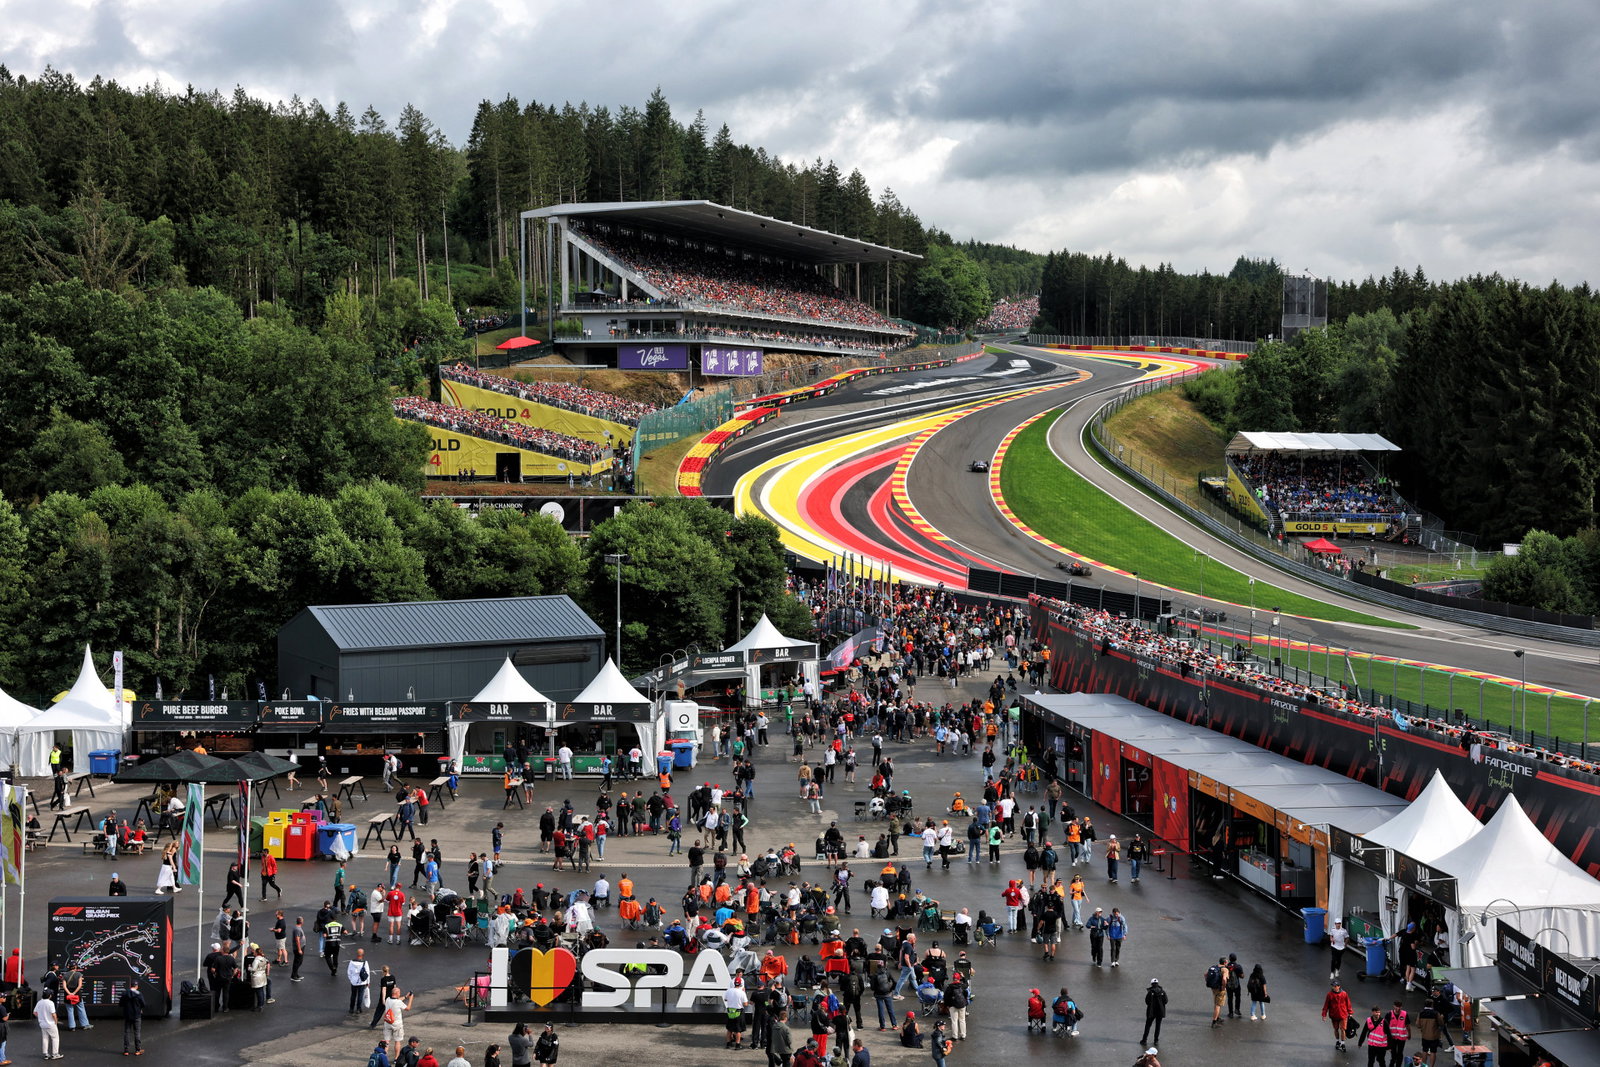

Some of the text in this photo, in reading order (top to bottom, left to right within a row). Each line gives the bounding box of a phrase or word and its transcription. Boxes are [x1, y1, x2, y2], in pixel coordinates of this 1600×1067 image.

[636, 348, 668, 367] Vegas
[520, 409, 531, 419] 4
[431, 438, 460, 451] OLD
[430, 454, 442, 466] 4
[776, 648, 789, 657] BAR
[162, 706, 228, 714] PURE BEEF BURGER
[274, 707, 305, 715] POKE BOWL
[342, 706, 426, 716] FRIES WITH BELGIAN PASSPORT
[490, 704, 509, 714] BAR
[594, 704, 612, 715] BAR
[1270, 698, 1299, 713] FANZONE
[1368, 740, 1373, 751] F
[1382, 738, 1386, 750] E
[1485, 756, 1532, 776] FANZONE
[1351, 837, 1364, 856] BAR
[1417, 864, 1430, 888] BAR
[53, 907, 84, 915] F1
[581, 948, 731, 1008] SPA
[1556, 966, 1568, 990] MEAT
